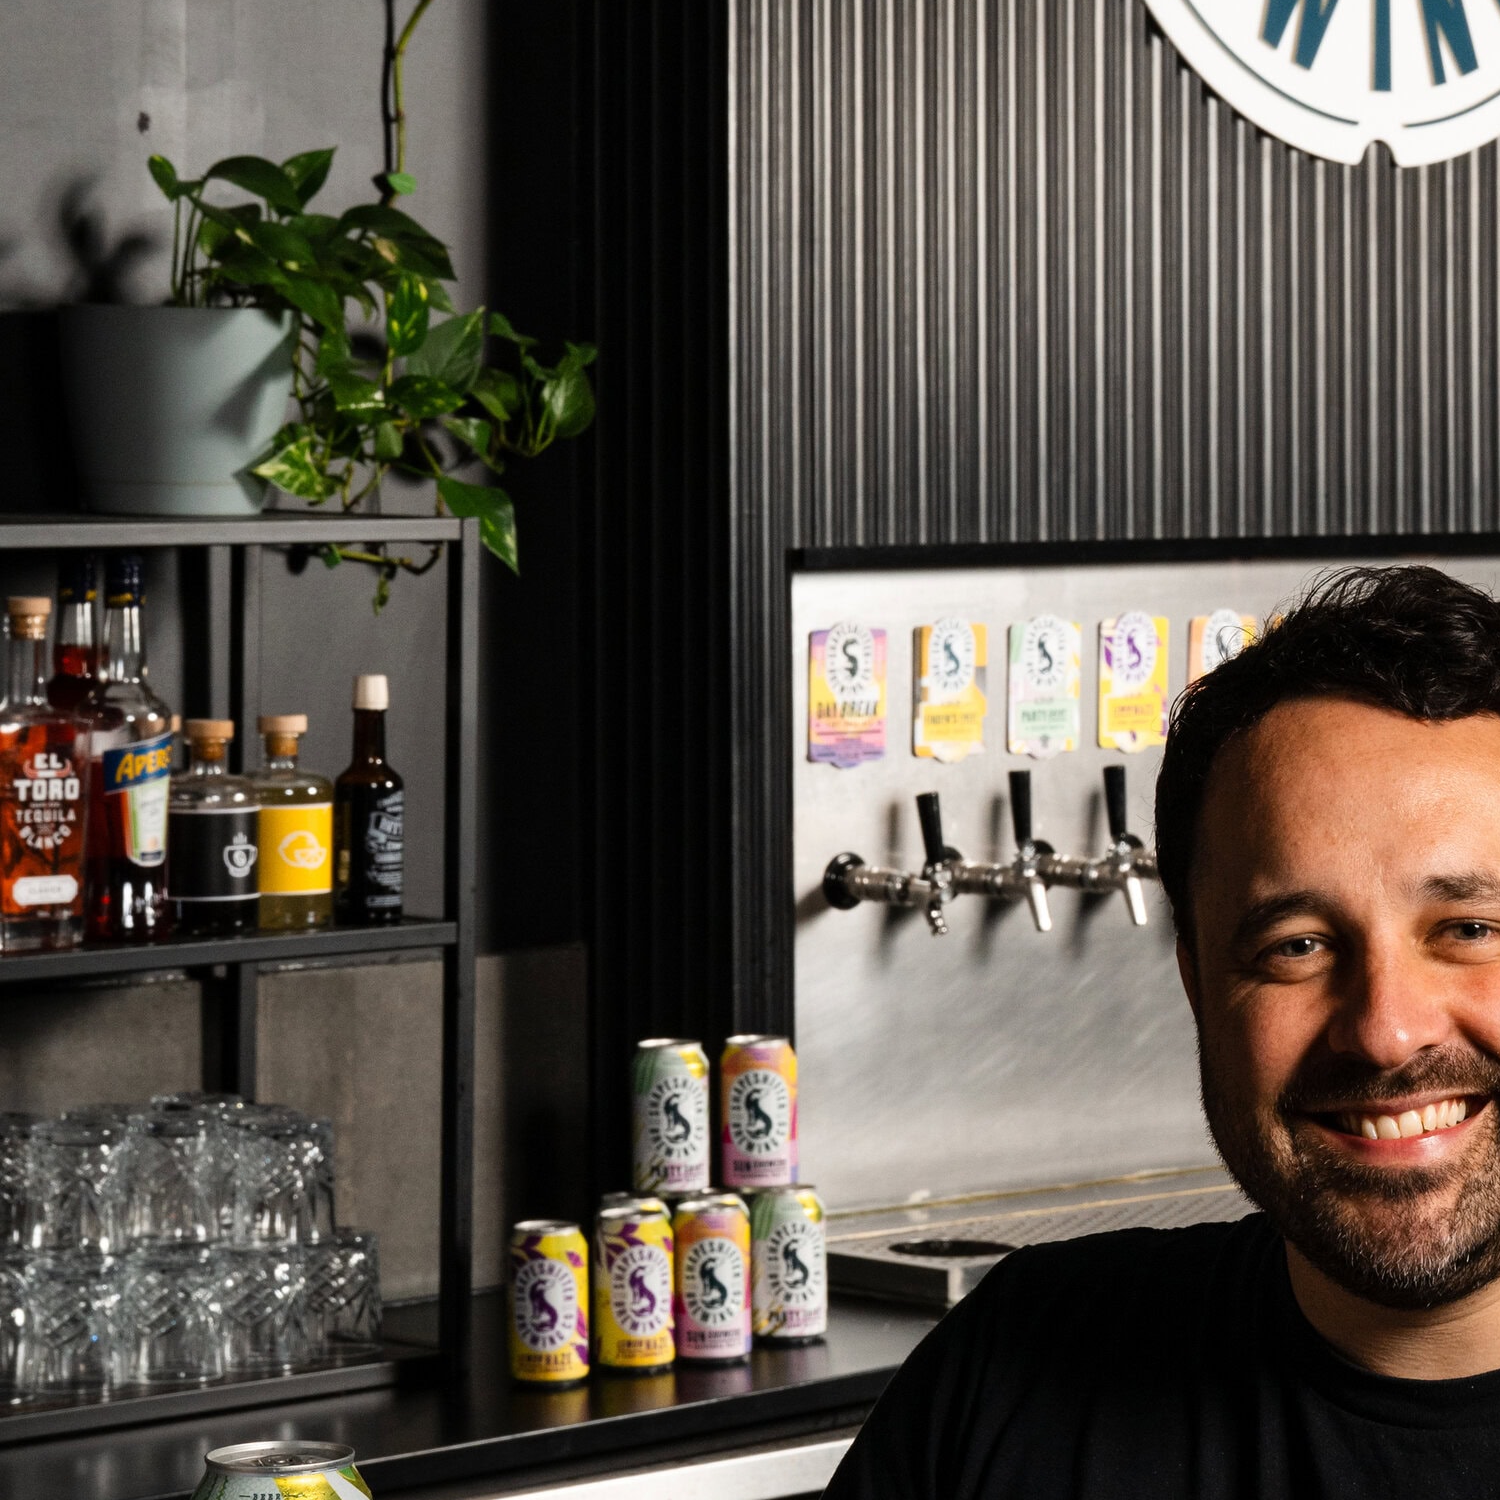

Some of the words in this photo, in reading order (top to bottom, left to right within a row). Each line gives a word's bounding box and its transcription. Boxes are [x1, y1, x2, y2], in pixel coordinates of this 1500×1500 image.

[34, 753, 63, 769] EL
[13, 778, 80, 801] TORO
[16, 809, 76, 823] TEQUILA
[19, 824, 72, 850] BLANCO
[253, 1493, 281, 1500] BEER
